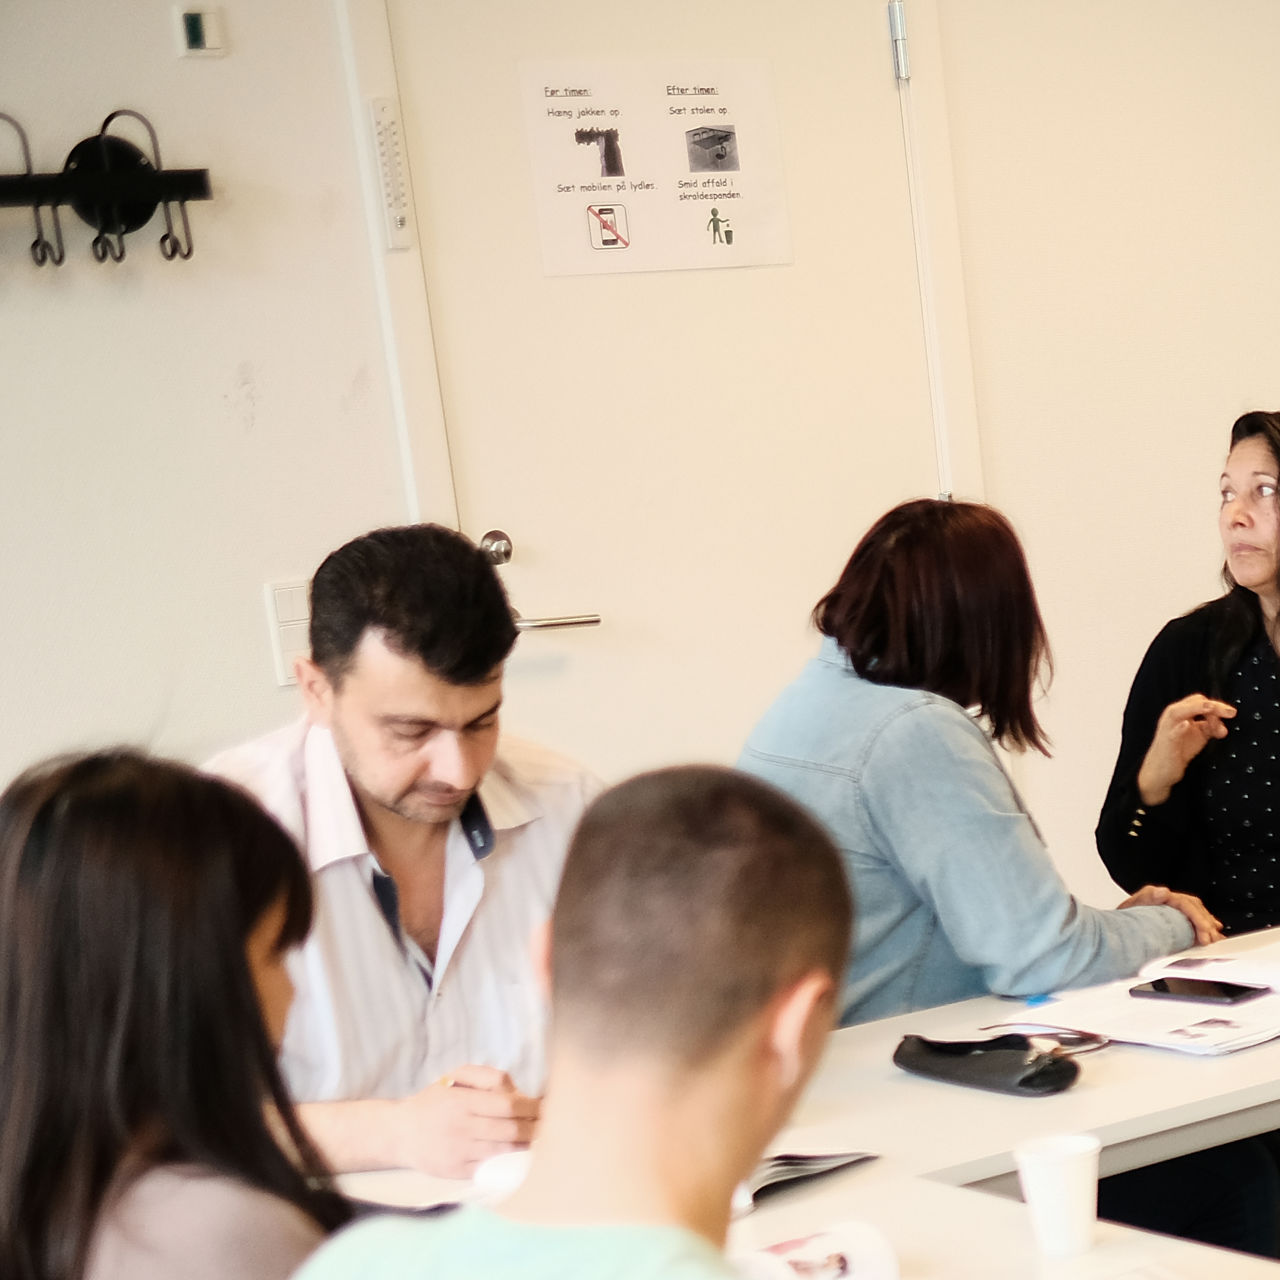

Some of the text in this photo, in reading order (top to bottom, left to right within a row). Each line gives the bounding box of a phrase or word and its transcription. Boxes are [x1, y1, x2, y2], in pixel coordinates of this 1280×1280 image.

[564, 87, 592, 97] timen:
[666, 85, 719, 95] Efter timen:
[548, 109, 573, 119] Hæng
[577, 108, 605, 119] jakken
[669, 106, 687, 115] Sæt
[690, 105, 716, 115] stolen
[557, 183, 576, 193] Sæt
[580, 183, 613, 193] mobilen
[616, 181, 628, 193] på
[678, 180, 698, 189] Smid
[702, 178, 728, 188] affald
[679, 191, 744, 202] skraldespanden.
